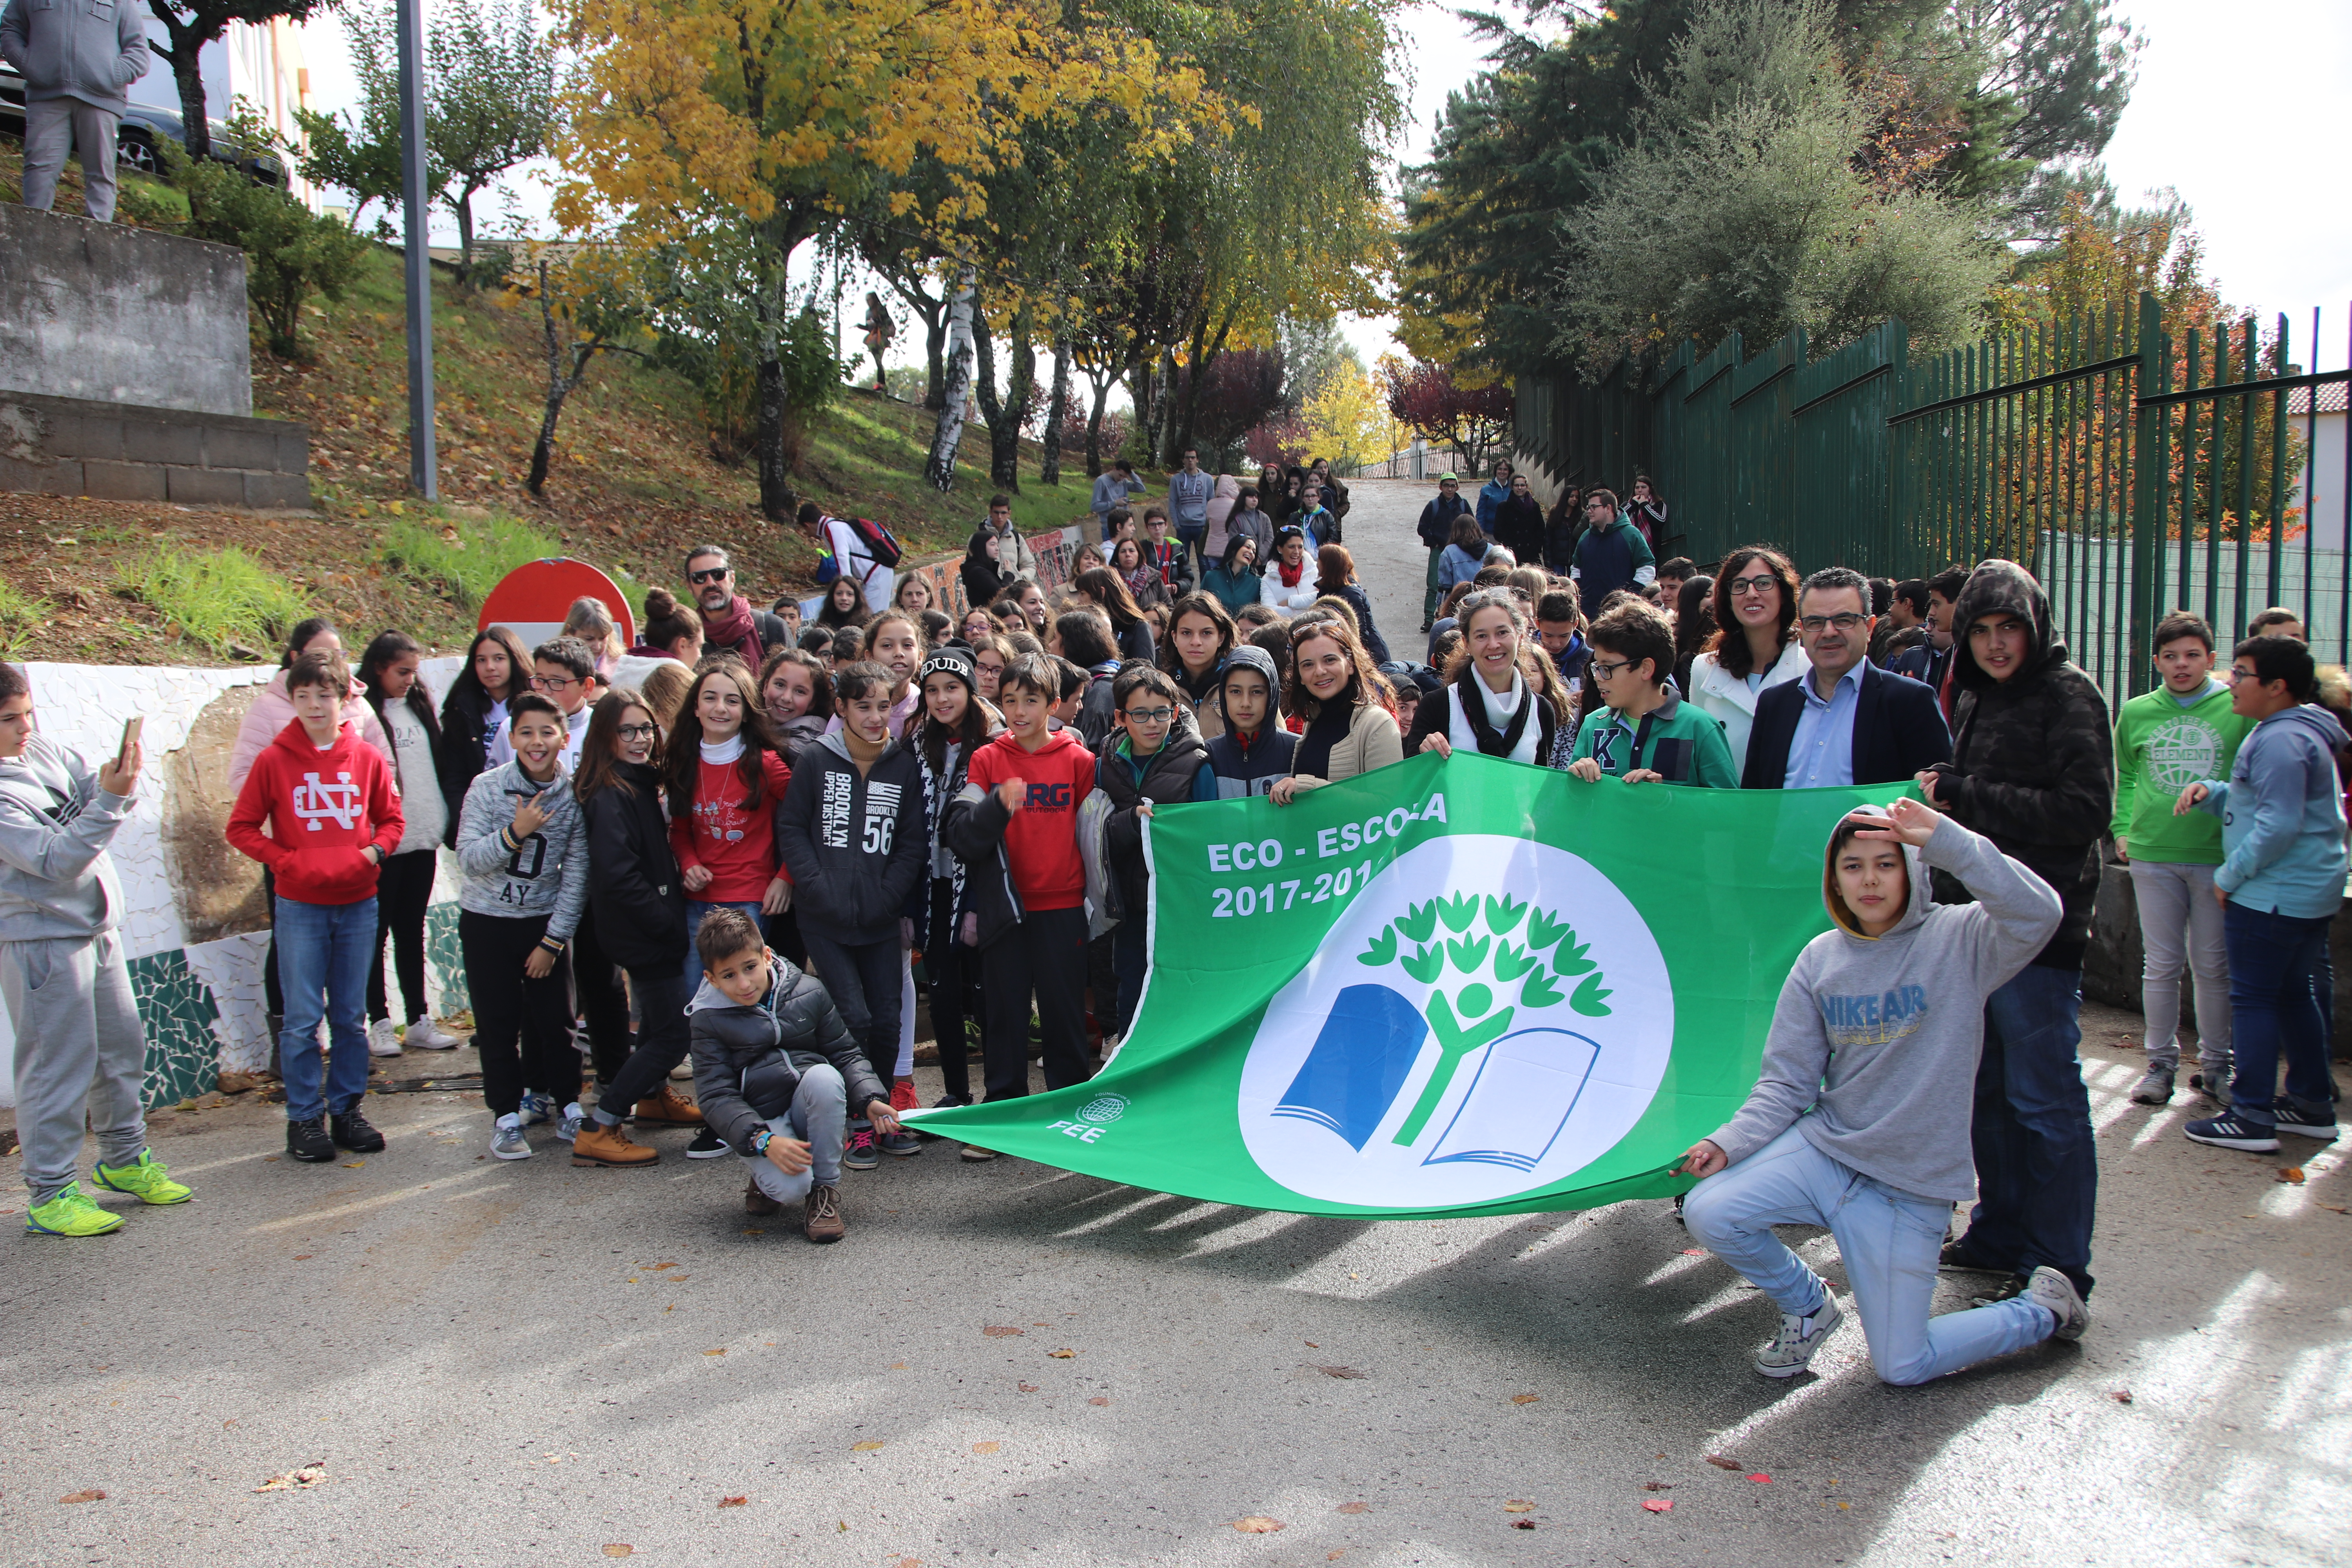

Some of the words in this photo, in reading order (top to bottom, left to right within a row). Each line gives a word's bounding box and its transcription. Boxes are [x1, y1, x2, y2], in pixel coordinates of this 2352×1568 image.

[1592, 728, 1621, 769] K
[2165, 717, 2180, 727] TO
[2180, 715, 2201, 726] THE
[2200, 720, 2225, 750] PLANET
[2154, 749, 2211, 761] ELEMENT
[823, 770, 835, 802] UPPER
[991, 782, 1070, 807] RG
[822, 803, 834, 847] DISTRICT
[831, 772, 852, 848] BROOKLYN
[866, 804, 898, 818] BROOKLYN
[862, 815, 895, 856] 56
[1207, 838, 1283, 872] ECO
[499, 881, 531, 906] AY
[1211, 856, 1384, 918] 2017-201
[1094, 1092, 1127, 1100] FOUNDATION
[1045, 1120, 1107, 1144] FEE
[1093, 1115, 1123, 1125] EDUCATION
